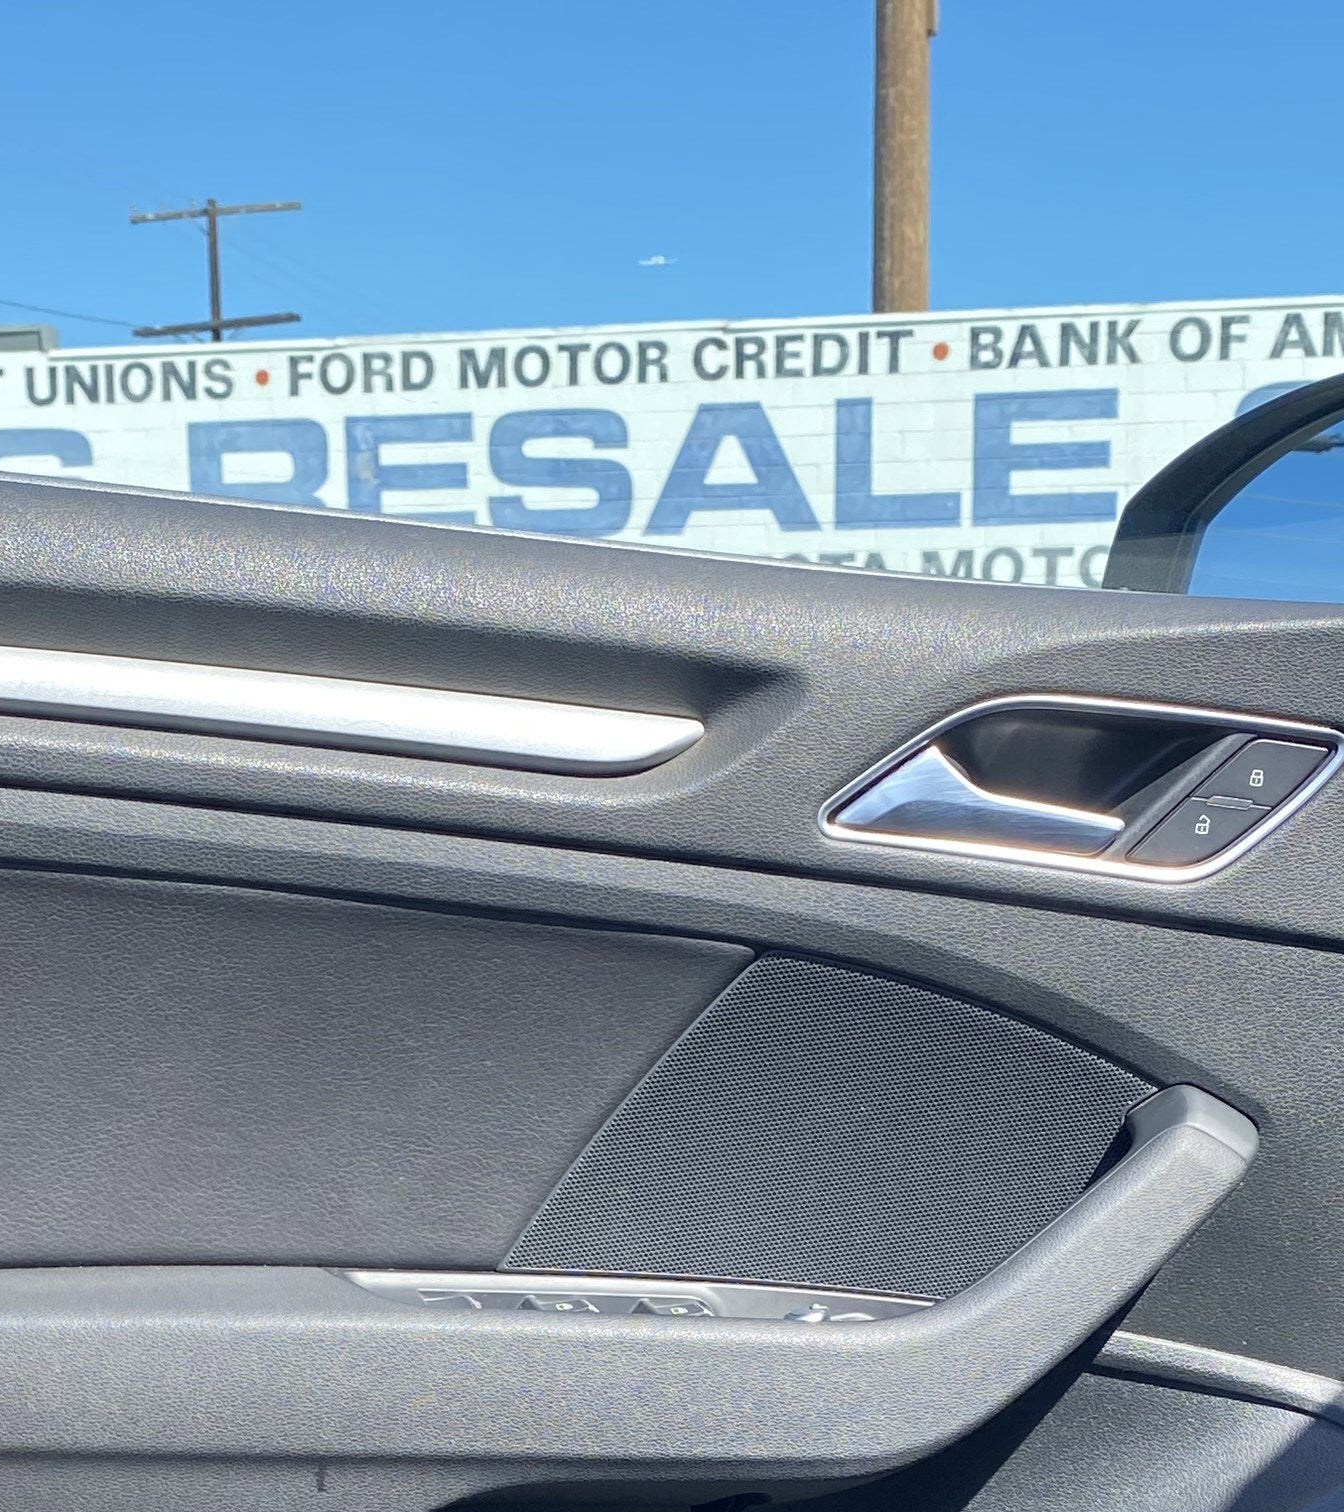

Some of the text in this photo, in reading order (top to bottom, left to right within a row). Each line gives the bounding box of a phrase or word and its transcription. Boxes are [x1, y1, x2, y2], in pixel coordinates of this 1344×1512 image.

[24, 358, 234, 408] UNIONS
[288, 349, 435, 397] FORD
[458, 340, 668, 389] MOTOR
[692, 329, 913, 381] CREDIT
[969, 318, 1143, 370] BANK
[1169, 314, 1250, 364] OF
[187, 387, 1121, 540] RESALE
